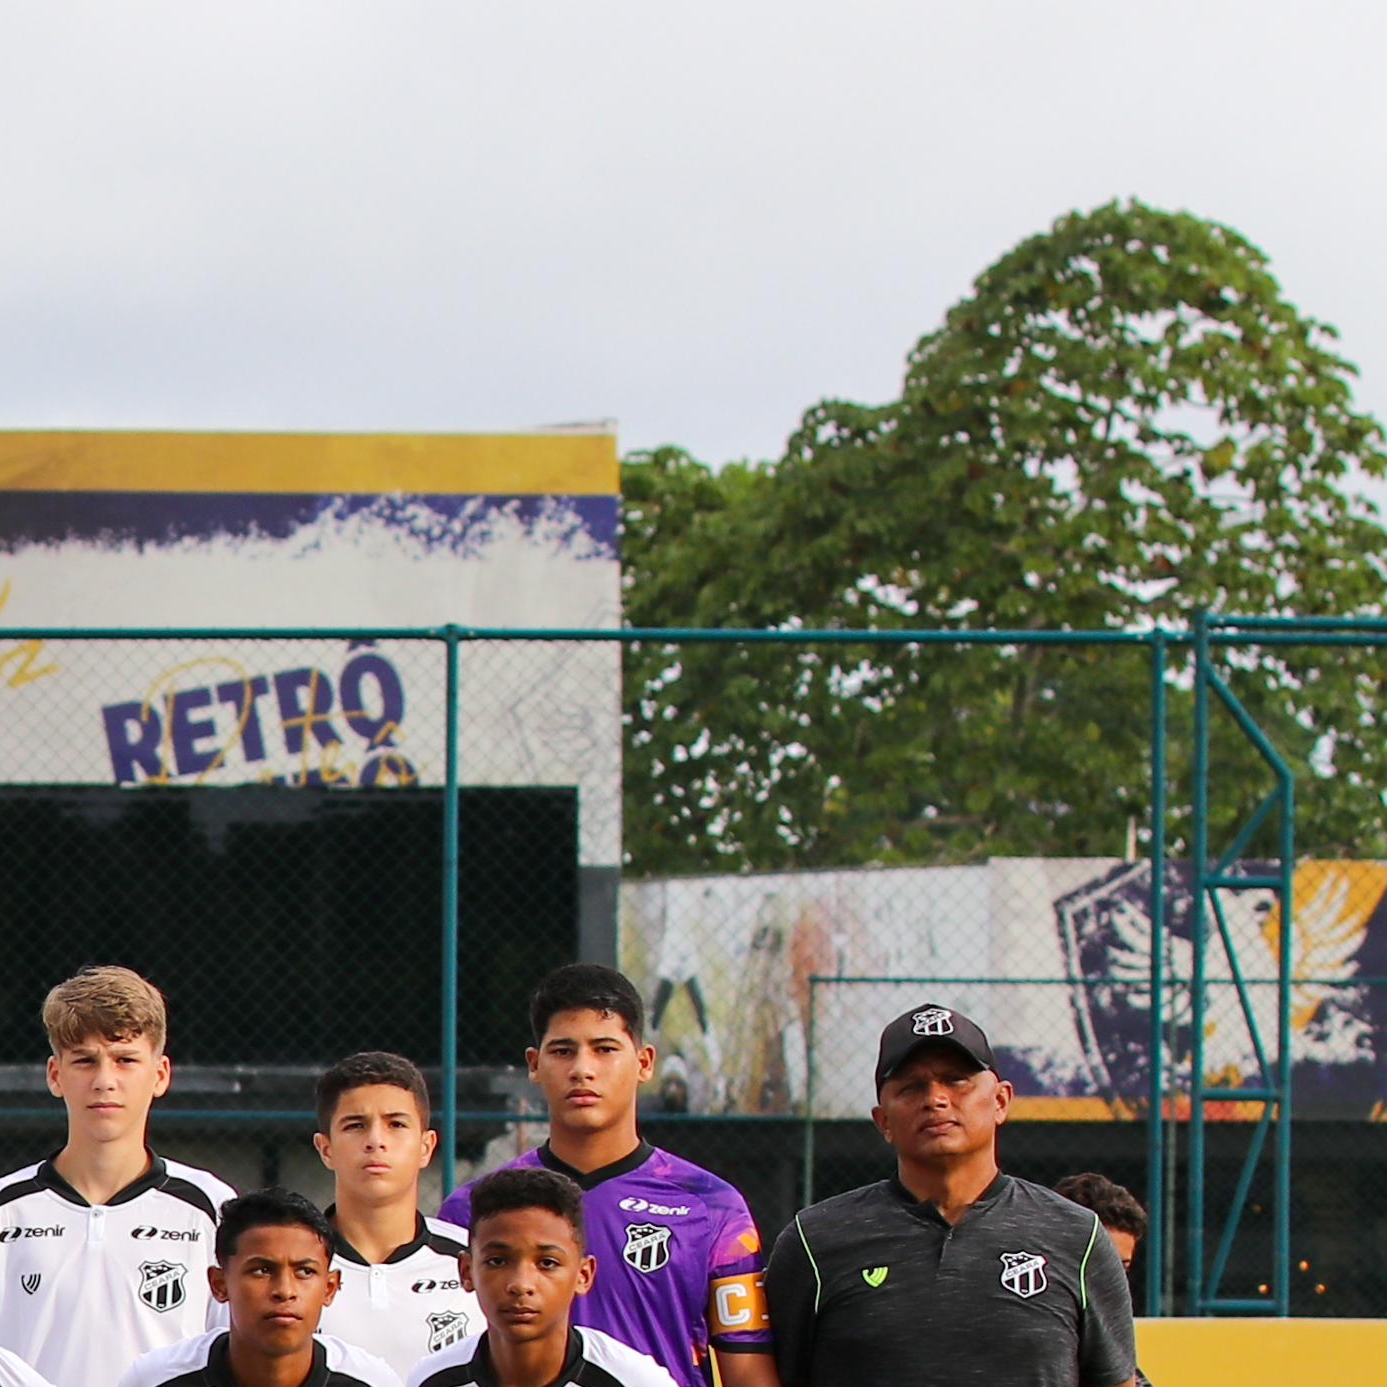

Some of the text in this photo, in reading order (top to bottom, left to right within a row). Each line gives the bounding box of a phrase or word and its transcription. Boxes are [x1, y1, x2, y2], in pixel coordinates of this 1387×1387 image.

[647, 1203, 691, 1216] zenir
[24, 1224, 201, 1242] zenir zenir
